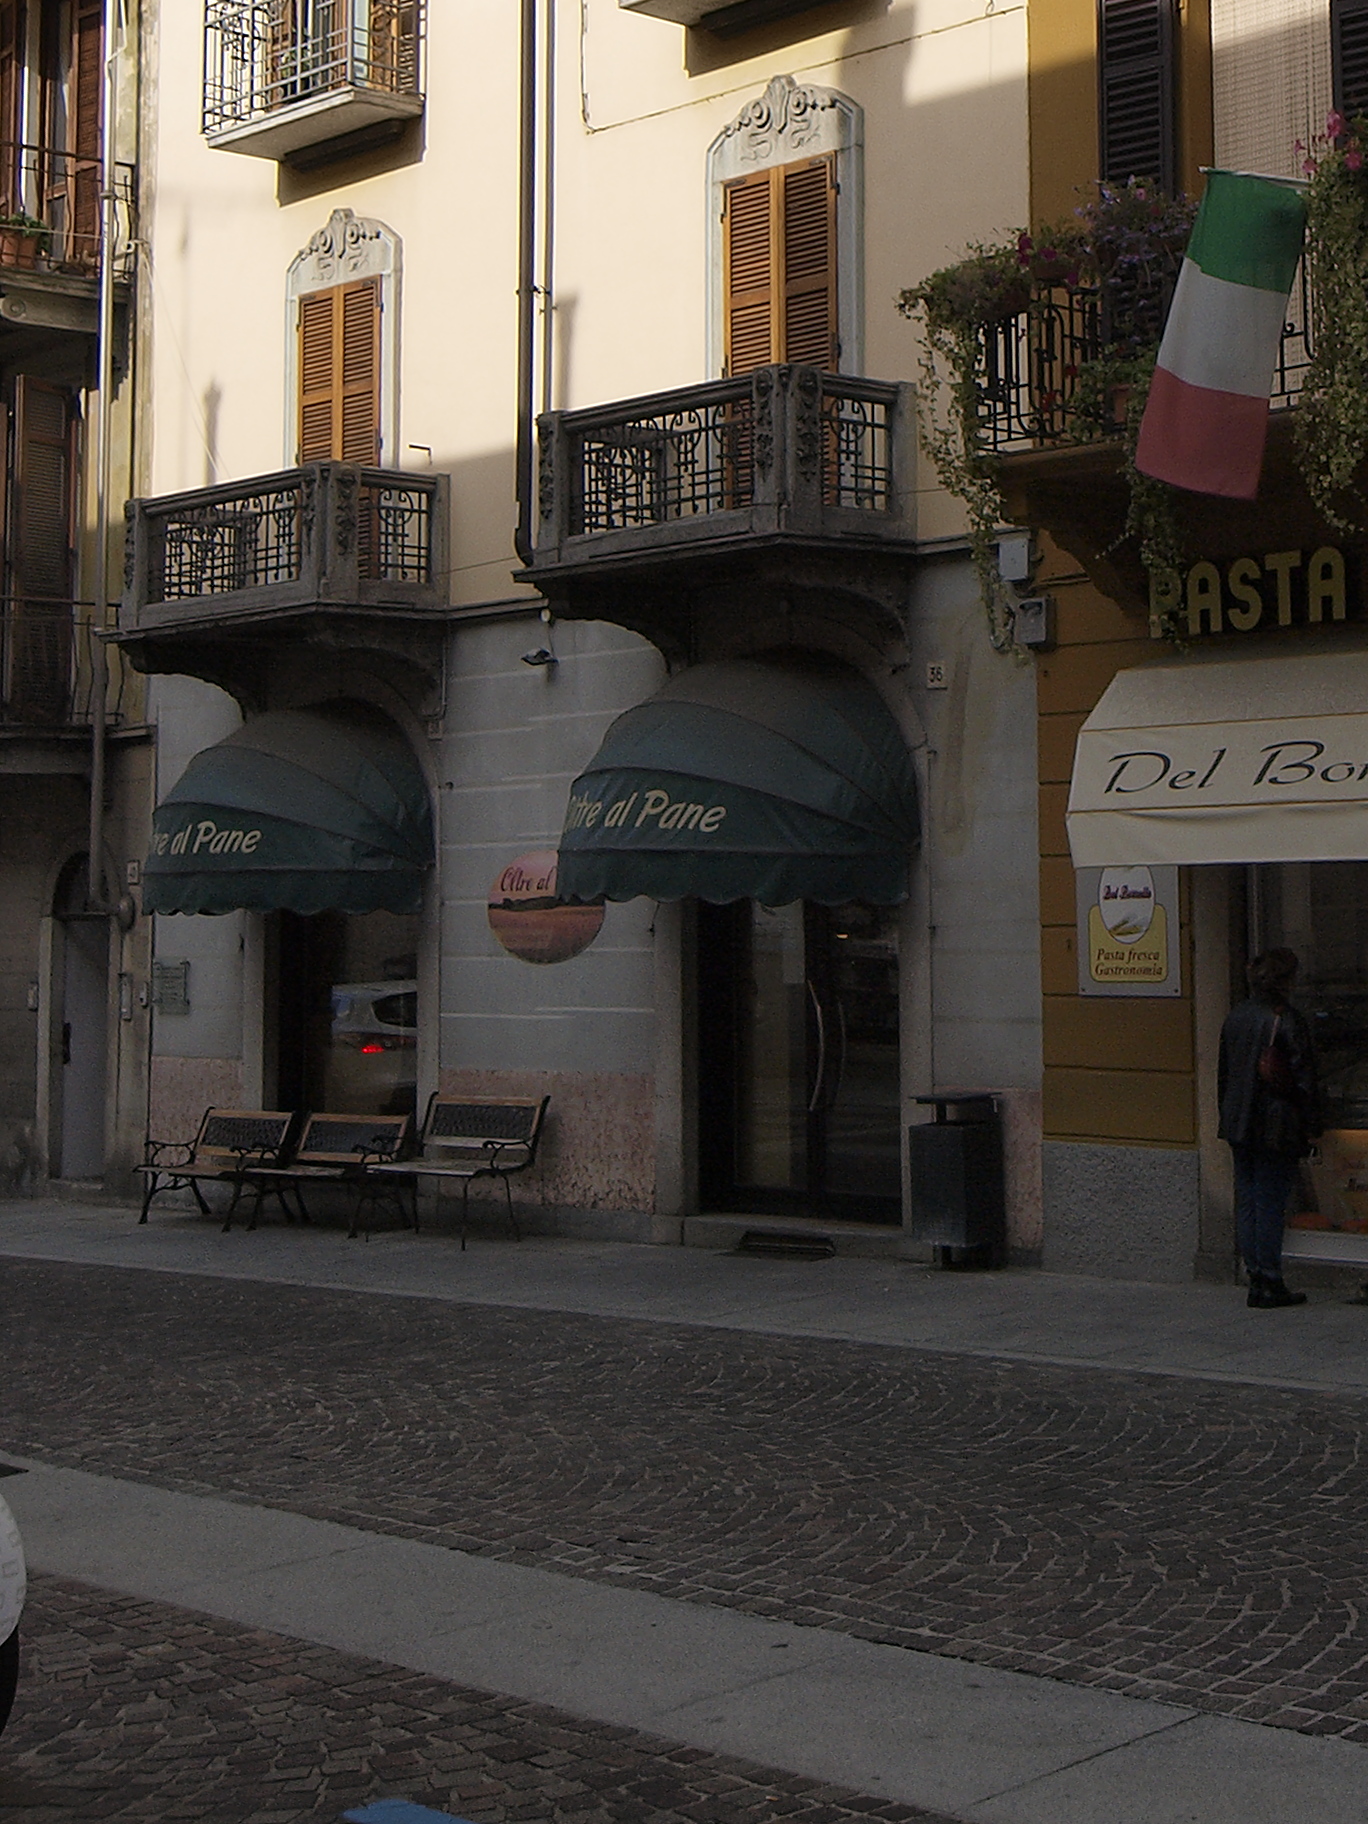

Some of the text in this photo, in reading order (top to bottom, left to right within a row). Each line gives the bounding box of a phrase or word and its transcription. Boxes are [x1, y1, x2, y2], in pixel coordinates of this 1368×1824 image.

[1149, 544, 1347, 639] PASTA
[1103, 748, 1227, 794] Del
[604, 791, 638, 828] al
[634, 788, 728, 834] Pane
[170, 824, 193, 855] al
[192, 819, 263, 855] Pane
[1095, 962, 1163, 976] Gastronomia
[1097, 947, 1160, 965] Pasta fresca
